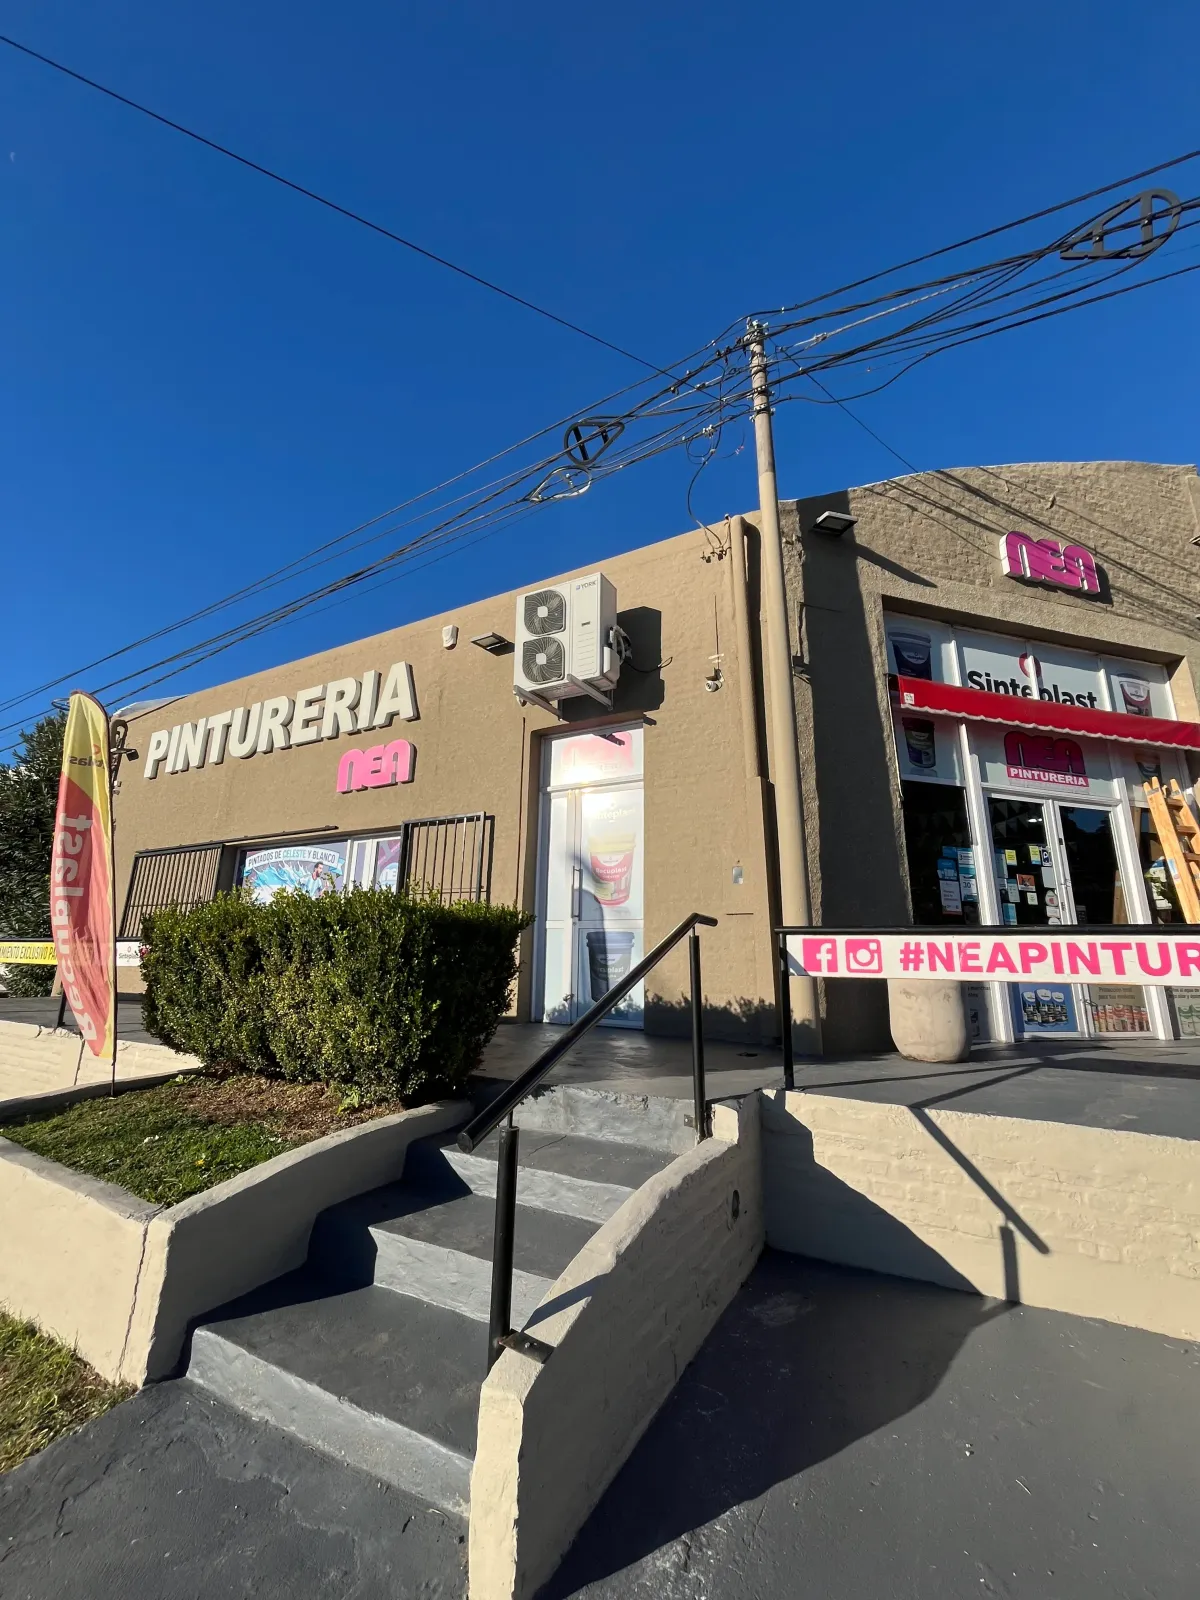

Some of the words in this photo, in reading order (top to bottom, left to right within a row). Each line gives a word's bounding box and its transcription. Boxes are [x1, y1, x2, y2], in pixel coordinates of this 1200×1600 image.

[581, 580, 597, 589] YORK
[144, 661, 417, 779] PINTURERIA
[337, 738, 414, 793] NEA
[1010, 767, 1087, 786] PINTURERIA
[248, 851, 274, 866] PINTADOS
[274, 850, 282, 860] DE
[282, 849, 306, 859] CELESTE
[307, 850, 312, 859] Y
[312, 850, 336, 864] BLANCO
[0, 945, 20, 958] MIENTO
